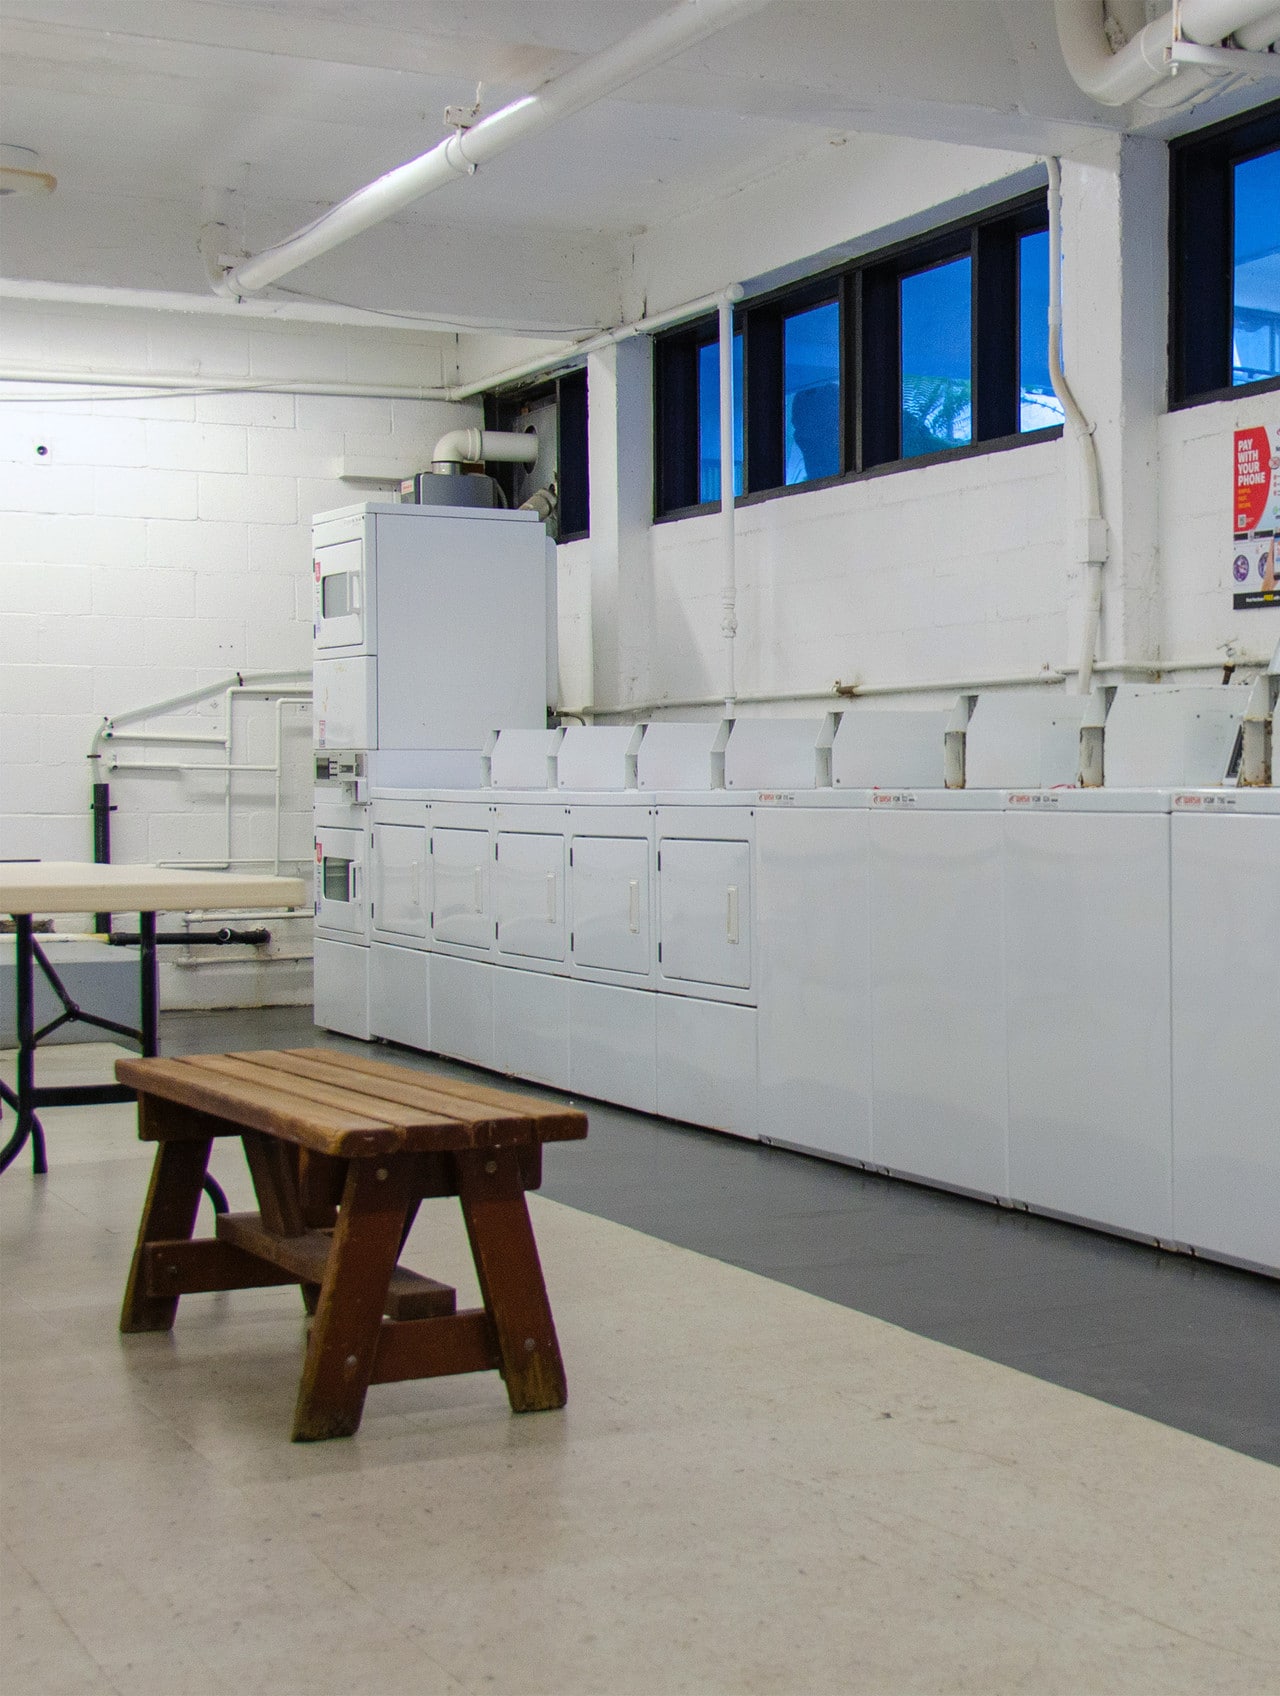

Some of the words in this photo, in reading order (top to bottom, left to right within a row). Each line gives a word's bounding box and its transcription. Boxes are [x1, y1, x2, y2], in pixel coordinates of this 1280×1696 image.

[1238, 438, 1253, 452] PAY
[1238, 449, 1258, 464] WITH
[1238, 461, 1260, 475] YOUR
[1238, 471, 1266, 487] PHONE
